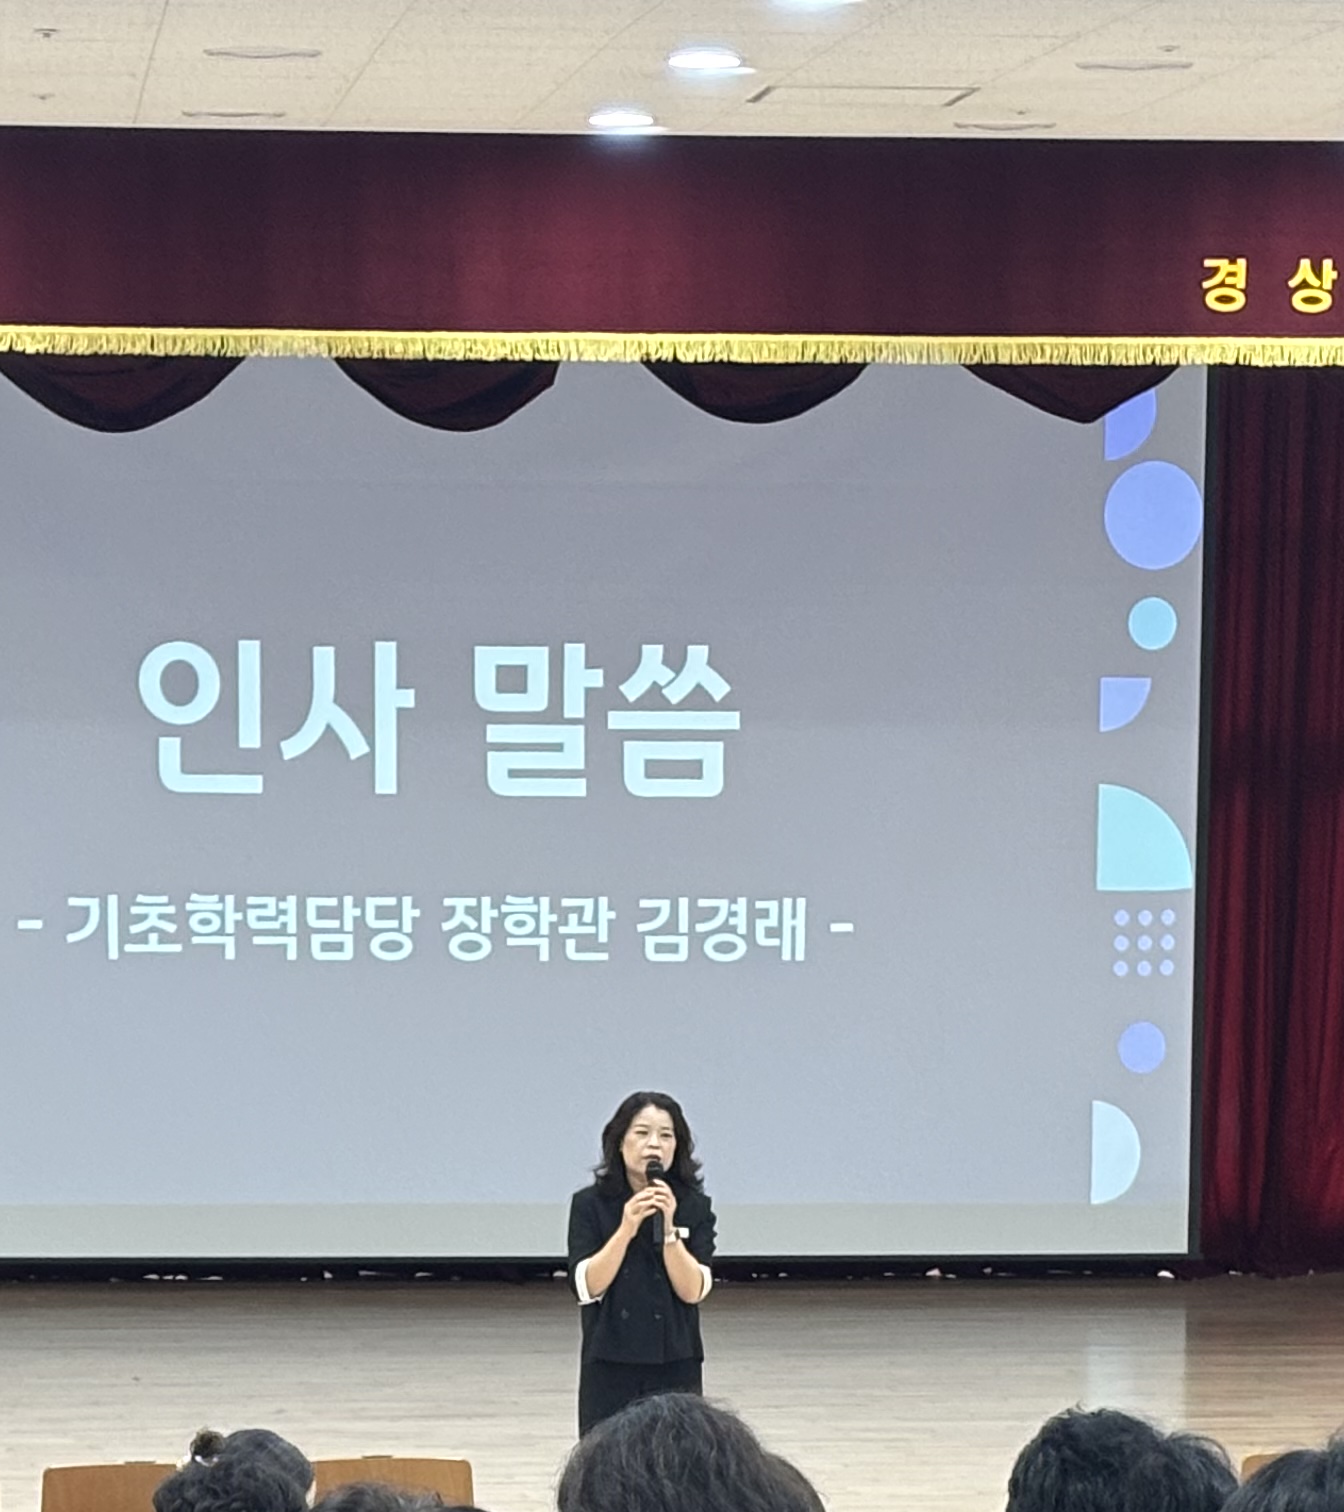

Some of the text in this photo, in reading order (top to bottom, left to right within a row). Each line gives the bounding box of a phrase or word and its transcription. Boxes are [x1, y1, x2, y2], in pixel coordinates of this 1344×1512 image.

[137, 638, 742, 799] 인사 말씀
[64, 892, 422, 963] 기초학력담당
[439, 894, 618, 963] 장학관
[635, 895, 808, 964] 김경래
